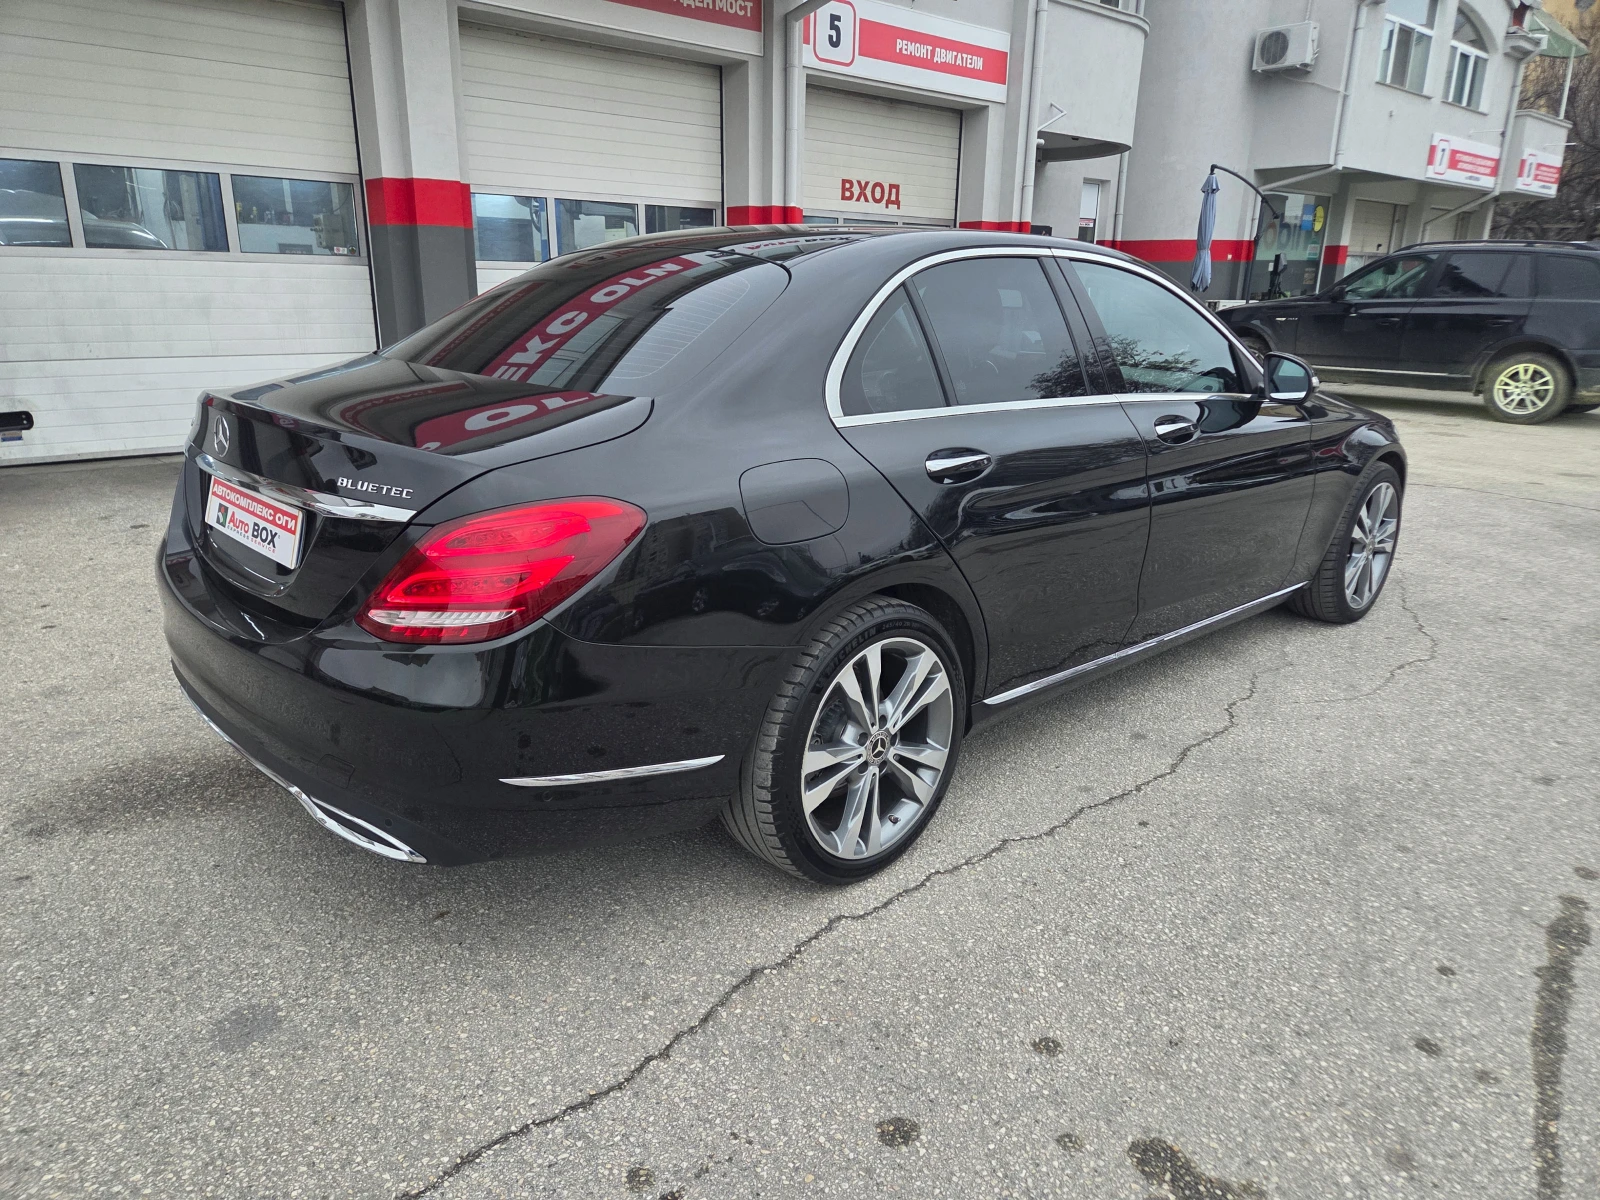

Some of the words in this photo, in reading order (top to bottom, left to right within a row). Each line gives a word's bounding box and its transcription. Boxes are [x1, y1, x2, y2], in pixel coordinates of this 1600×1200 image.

[715, 0, 754, 17] МОСТ
[827, 13, 842, 49] 5
[896, 38, 933, 61] РЕМОНТ
[933, 46, 984, 71] ДВИГАТЕЛИ
[840, 178, 902, 210] ВХОД
[337, 477, 414, 499] BLUETEC
[213, 483, 274, 520] АВТОКОМПЛЕКС
[275, 513, 295, 531] ОГИ
[251, 521, 278, 549] BOX
